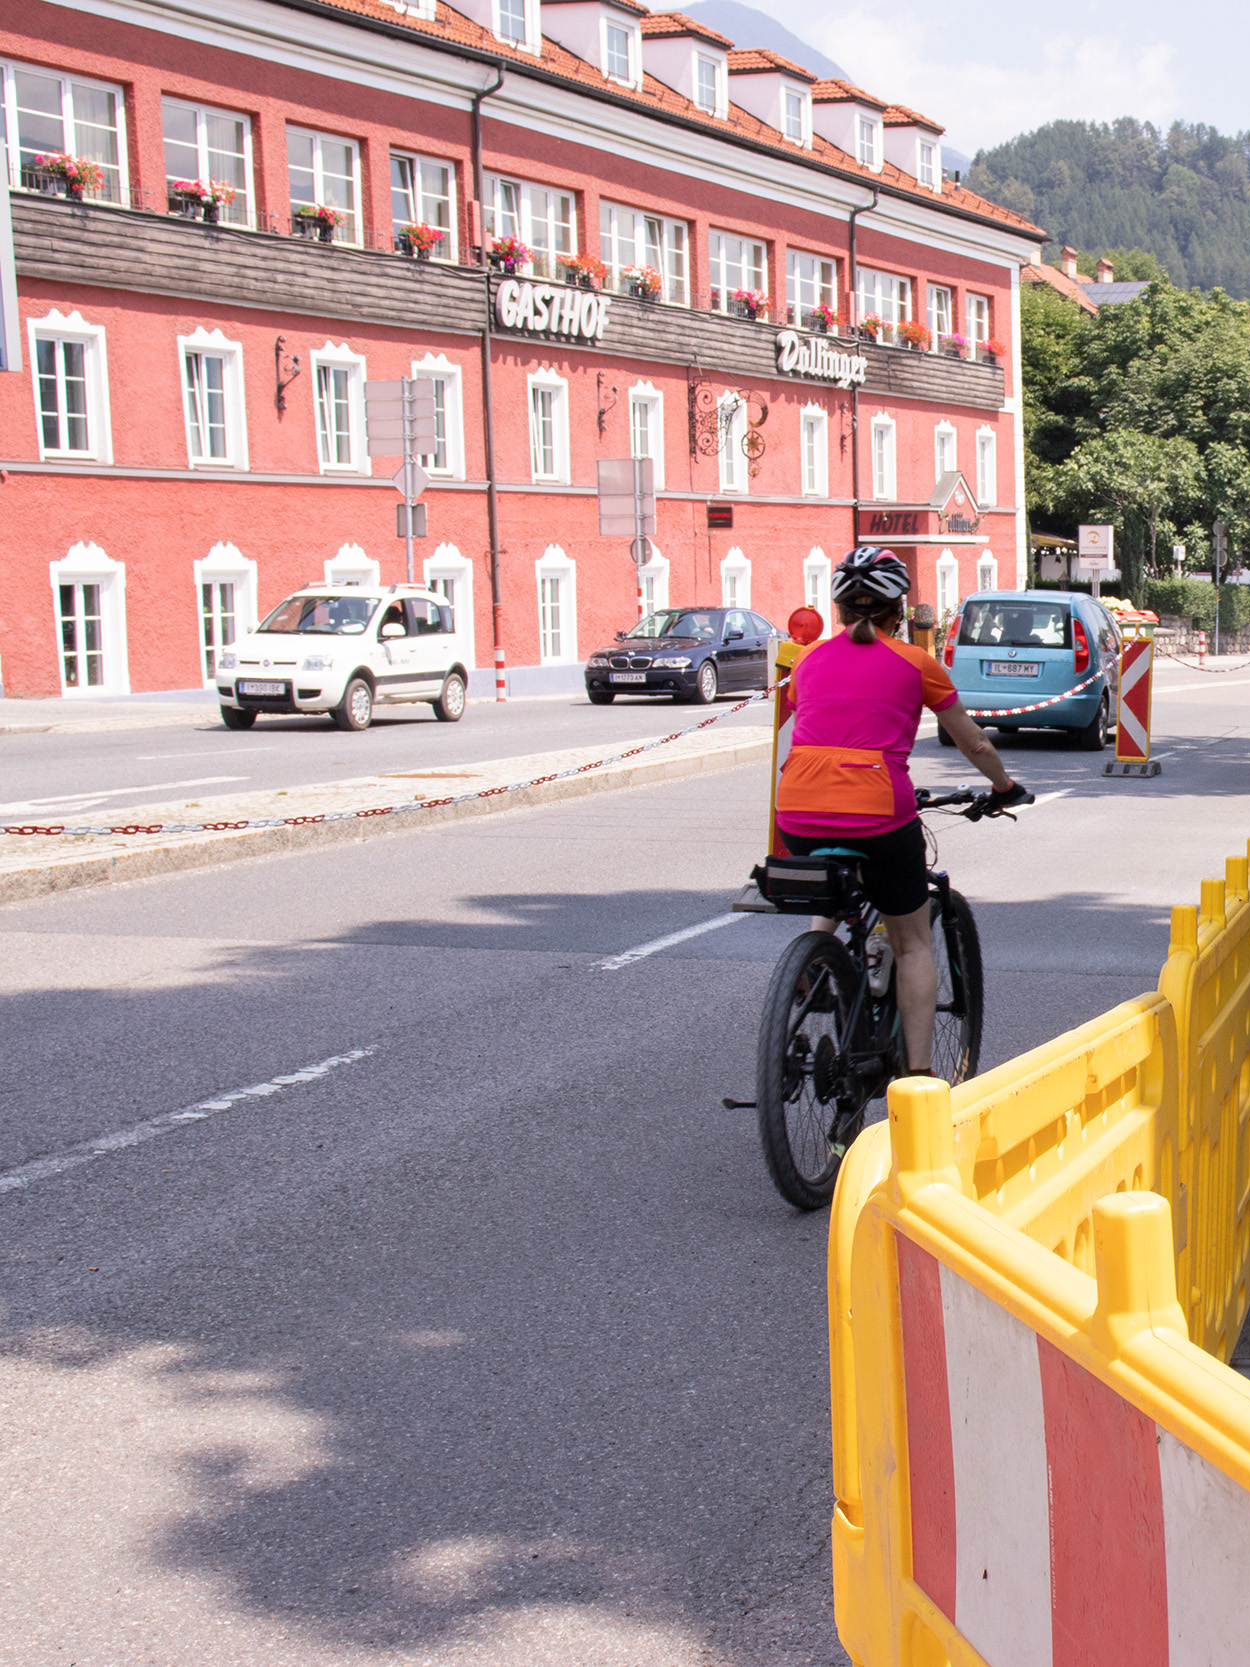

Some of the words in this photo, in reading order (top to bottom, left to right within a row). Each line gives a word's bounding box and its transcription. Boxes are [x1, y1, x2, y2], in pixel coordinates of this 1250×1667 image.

[496, 280, 612, 340] GASTHOF
[777, 330, 868, 388] Dollinger
[869, 513, 919, 533] HOTEL
[994, 664, 1001, 672] IL
[1007, 664, 1022, 673] 687
[1023, 665, 1034, 673] MY
